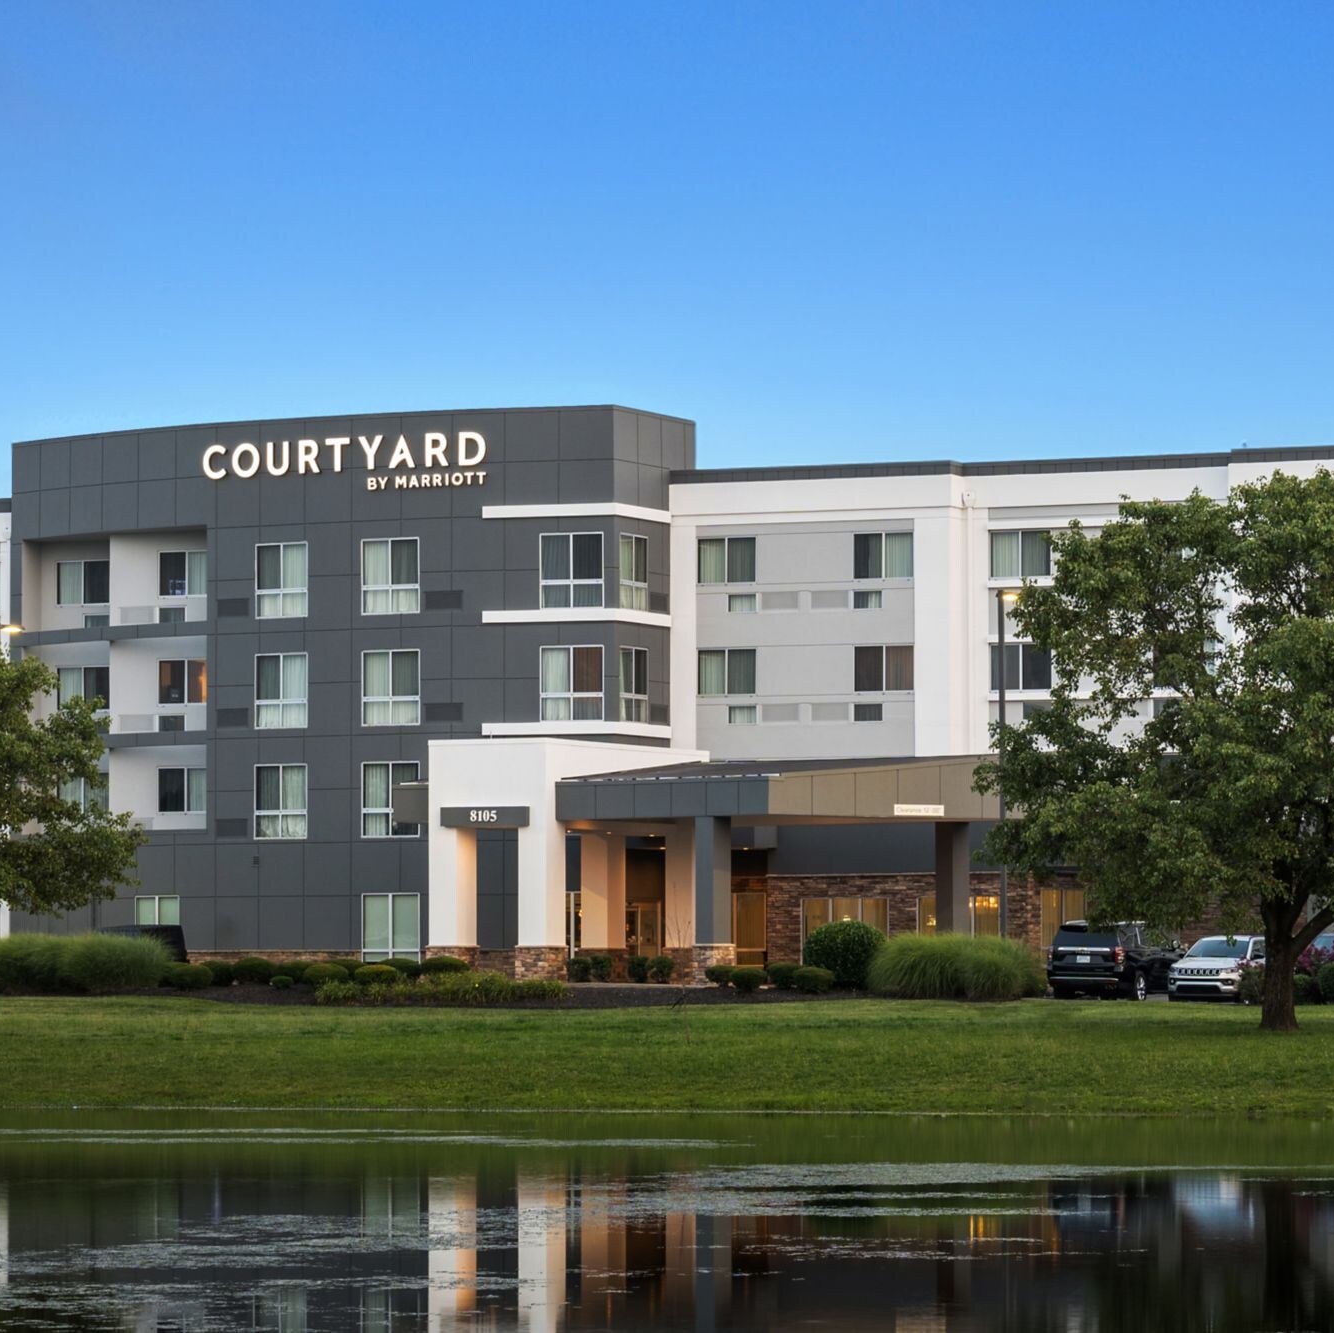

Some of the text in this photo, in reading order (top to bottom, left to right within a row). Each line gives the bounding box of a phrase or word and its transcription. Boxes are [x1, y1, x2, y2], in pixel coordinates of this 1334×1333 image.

[202, 431, 487, 480] COURTYARD
[366, 471, 487, 491] BY MARRIOTT
[469, 810, 498, 822] 8105
